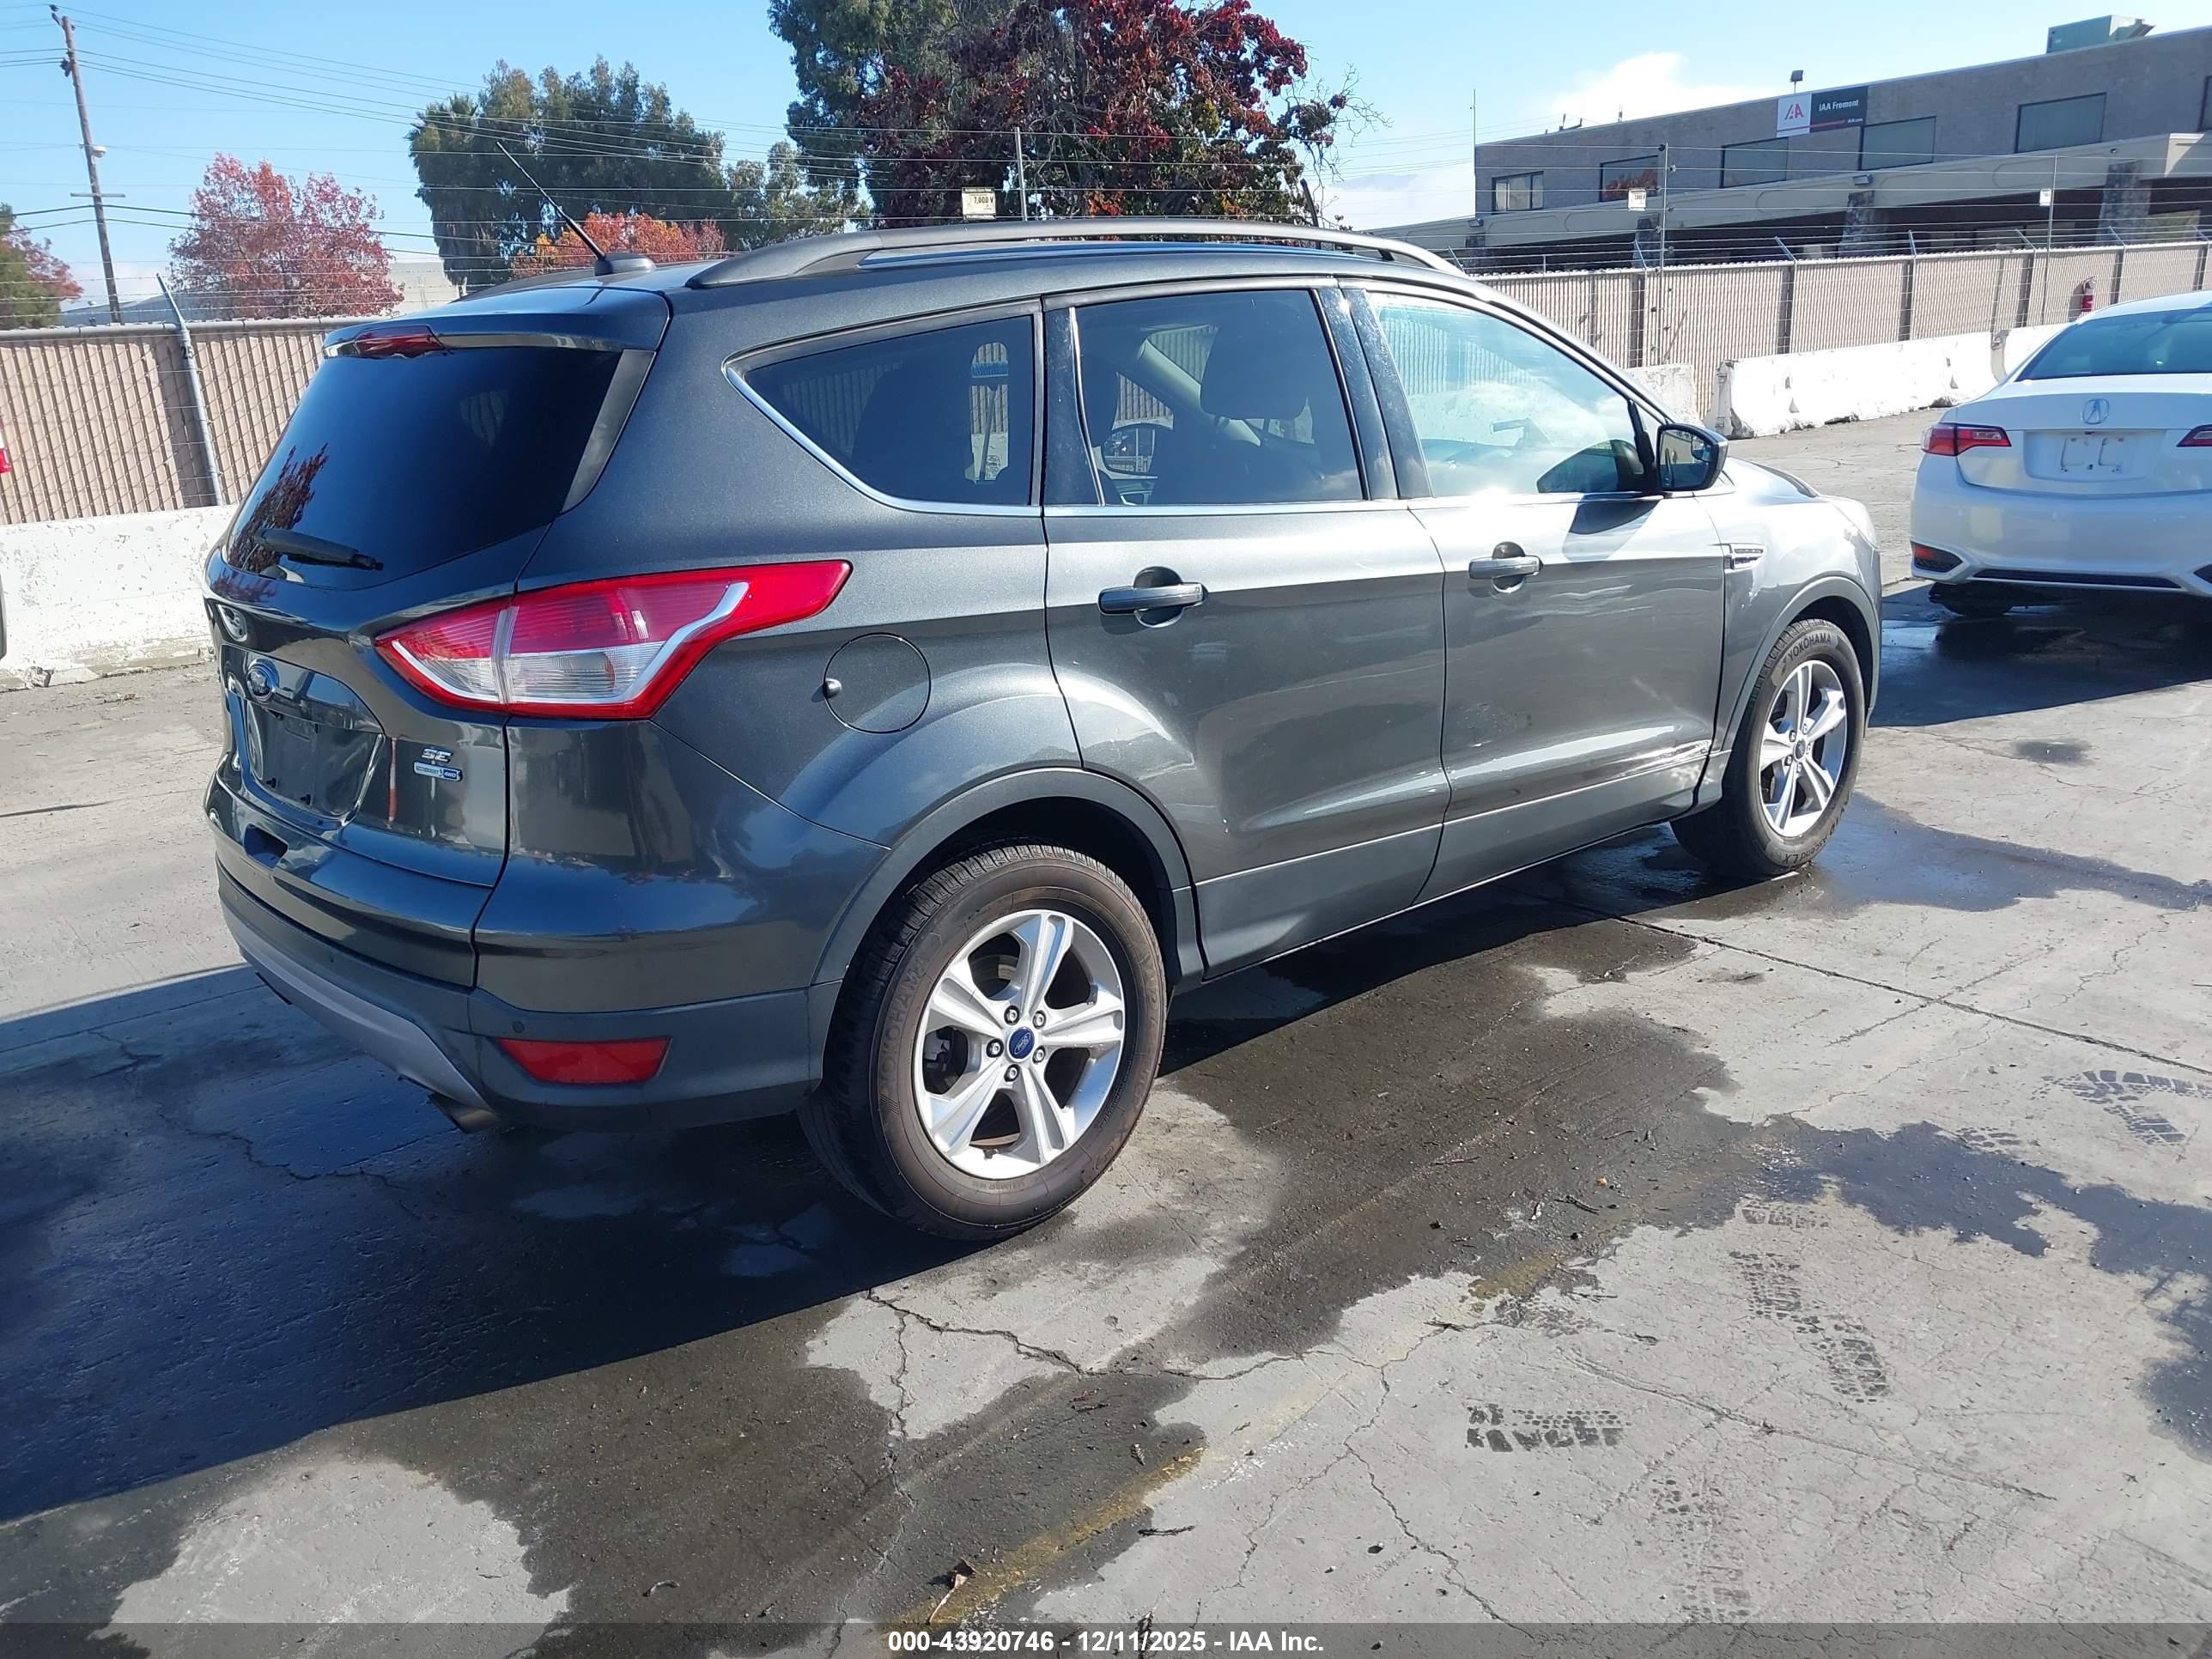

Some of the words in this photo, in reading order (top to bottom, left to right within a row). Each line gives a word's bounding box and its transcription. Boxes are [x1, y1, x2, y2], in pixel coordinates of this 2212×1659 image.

[1819, 102, 1831, 112] IAA
[180, 345, 194, 360] 25
[1787, 632, 1832, 661] YOKOHAMA
[422, 748, 452, 762] SE
